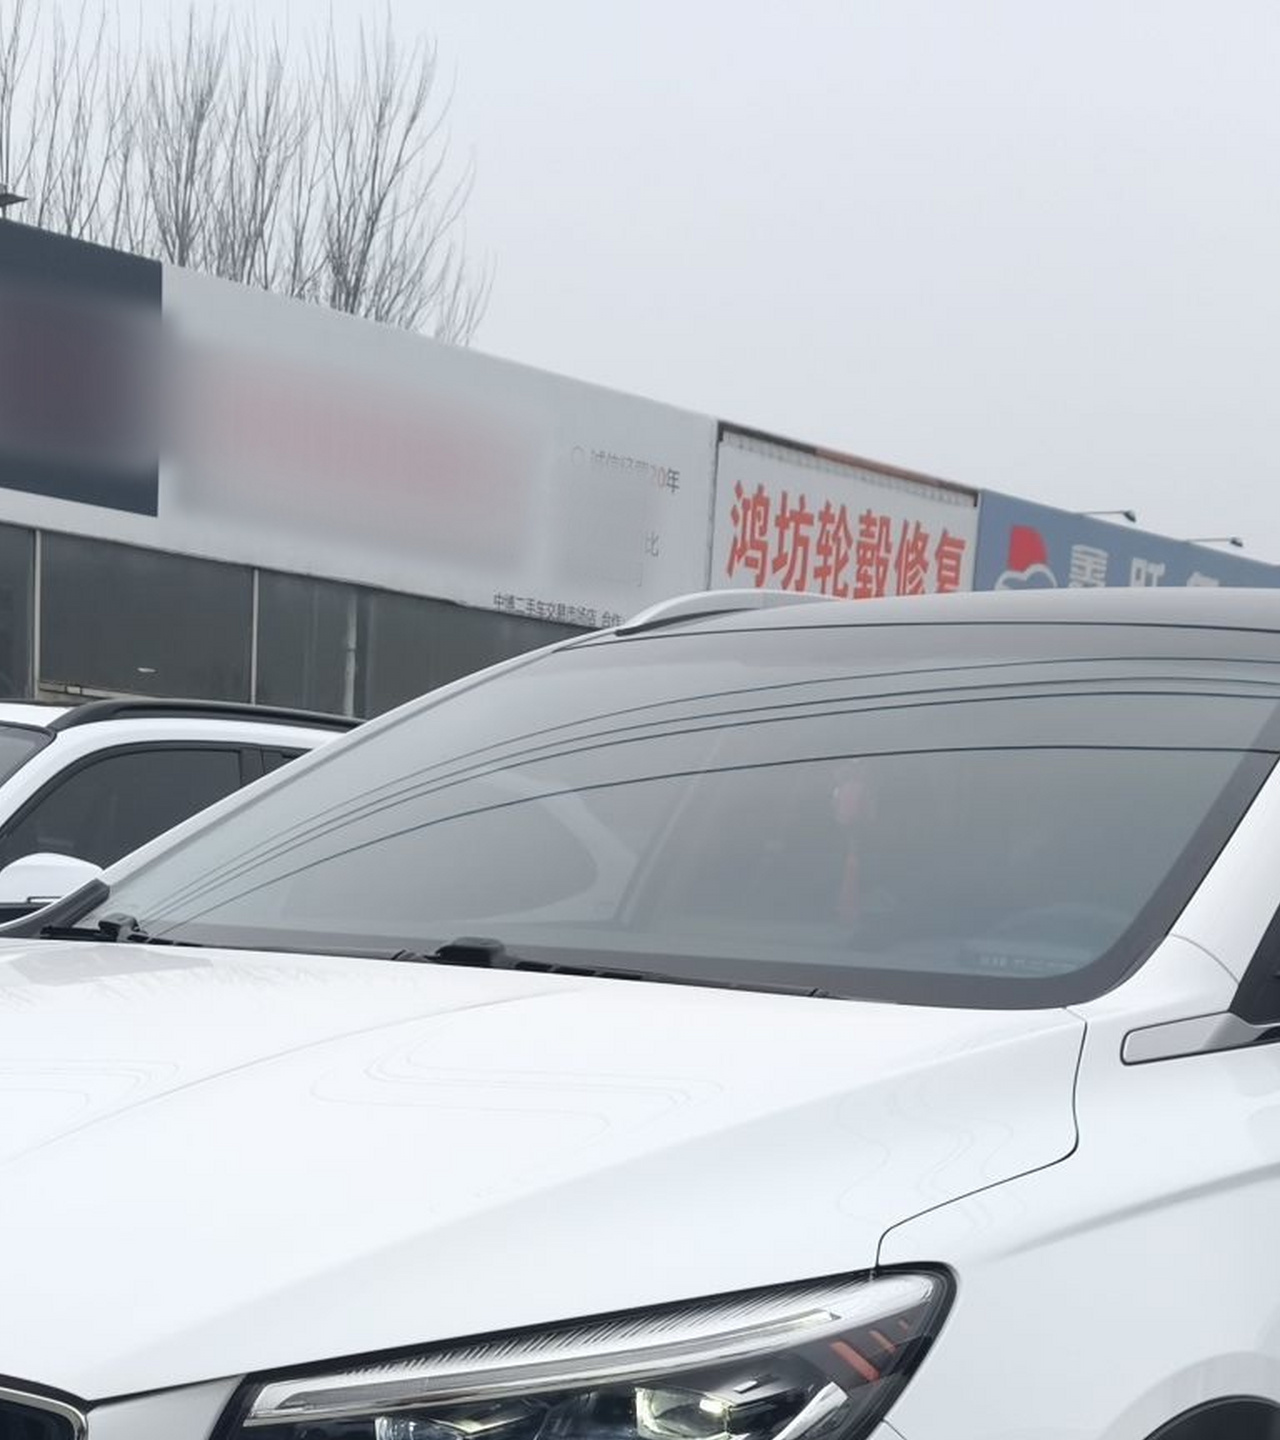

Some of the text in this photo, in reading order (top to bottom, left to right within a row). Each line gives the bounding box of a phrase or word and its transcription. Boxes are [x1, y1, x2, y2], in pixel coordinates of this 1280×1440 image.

[725, 479, 968, 599] 鸿坊轮毂修复
